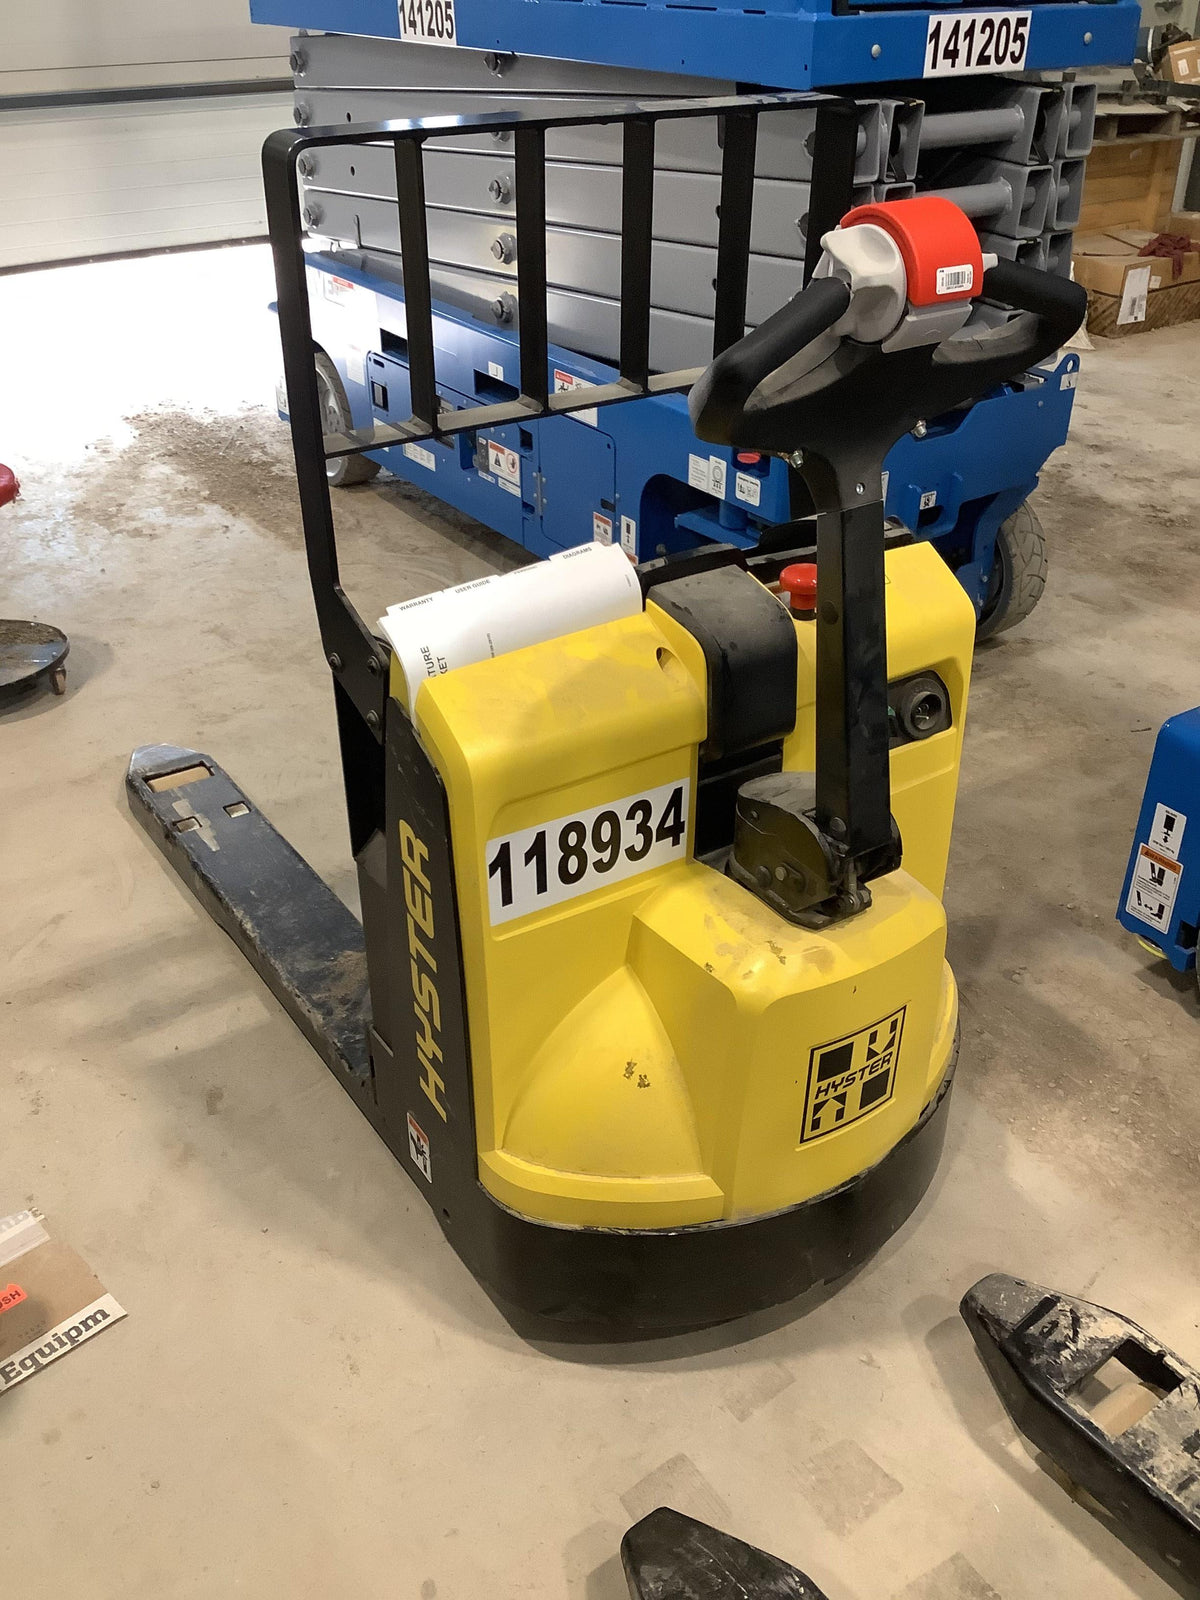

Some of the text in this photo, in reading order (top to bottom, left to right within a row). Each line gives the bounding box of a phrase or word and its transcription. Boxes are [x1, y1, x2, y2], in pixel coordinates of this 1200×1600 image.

[400, 0, 454, 39] 141205
[928, 17, 1028, 69] 141205
[562, 547, 593, 559] DIAGRAMS
[399, 597, 434, 611] WARRANTY
[455, 579, 491, 594] USER GUIDE
[420, 645, 437, 678] TURE
[488, 786, 685, 907] 118934
[399, 819, 447, 1123] HYSTER
[815, 1051, 893, 1100] HYSTER
[1, 1308, 110, 1385] Equipm
